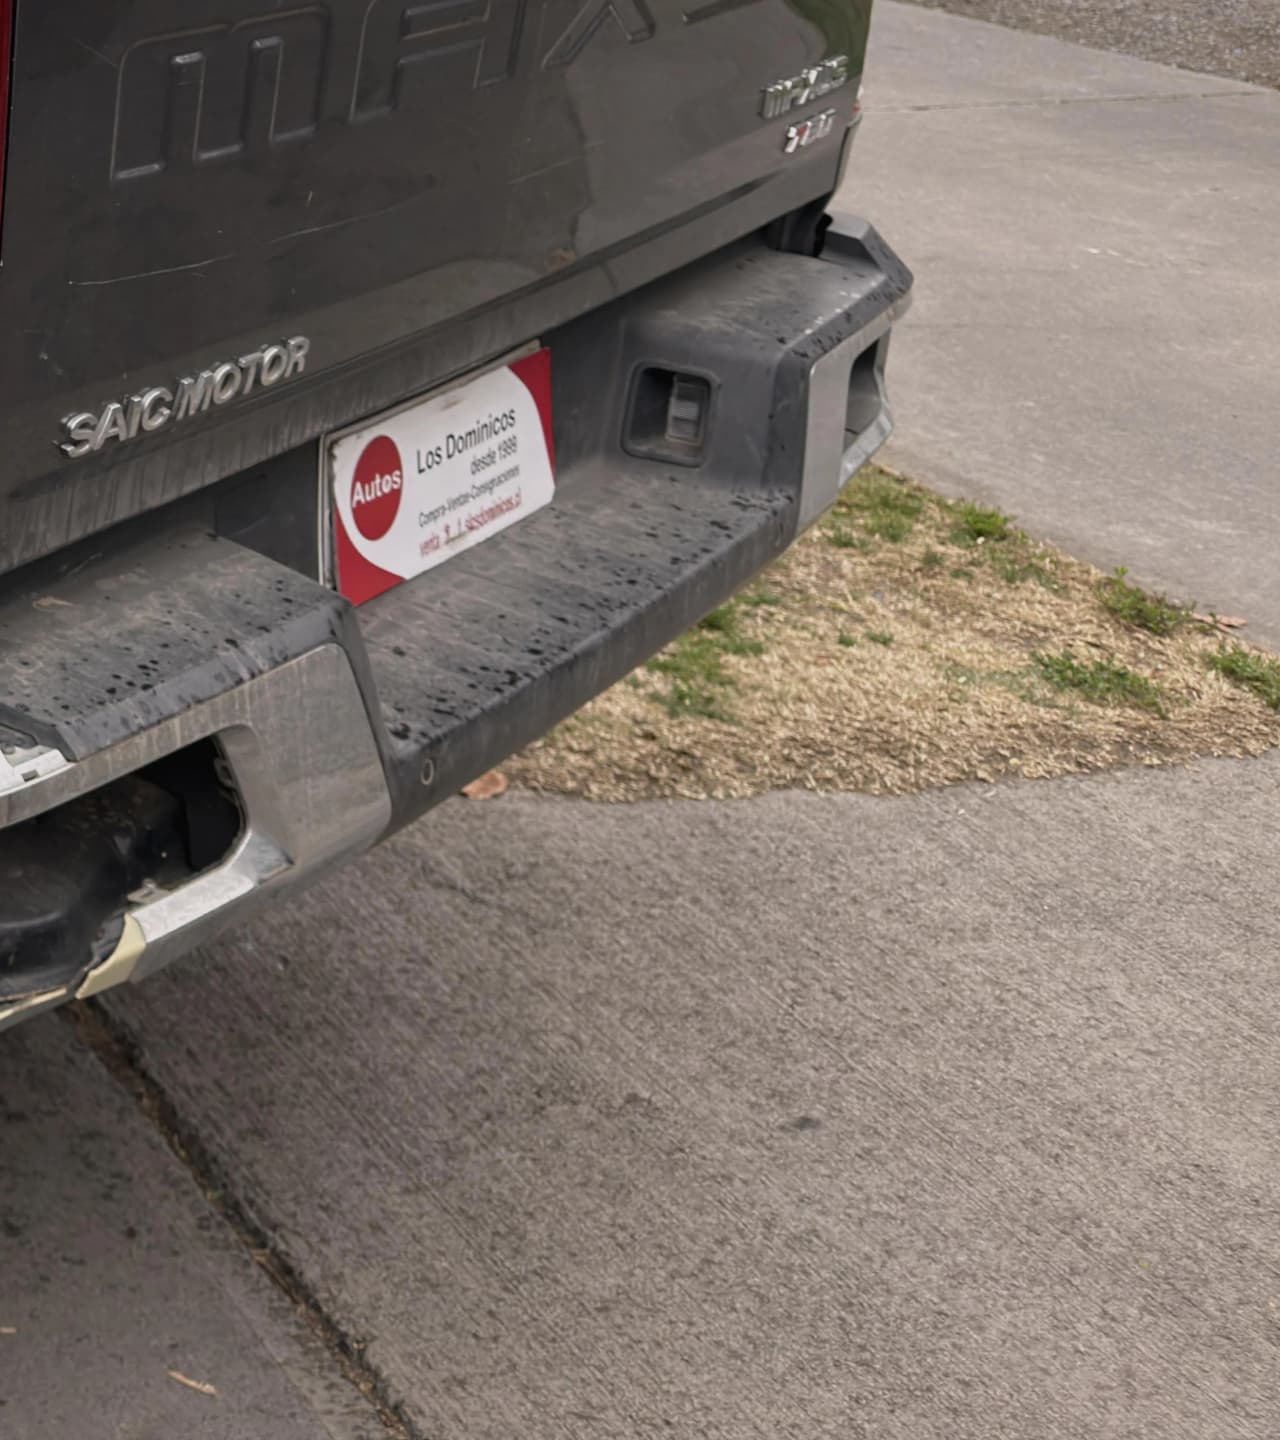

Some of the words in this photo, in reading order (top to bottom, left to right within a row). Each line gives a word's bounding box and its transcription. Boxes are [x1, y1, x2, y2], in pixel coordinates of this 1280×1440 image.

[58, 386, 173, 459] SAIC
[172, 336, 310, 421] MOTOR
[416, 445, 443, 474] Los
[445, 408, 517, 460] Dominicos
[351, 469, 403, 508] Autos
